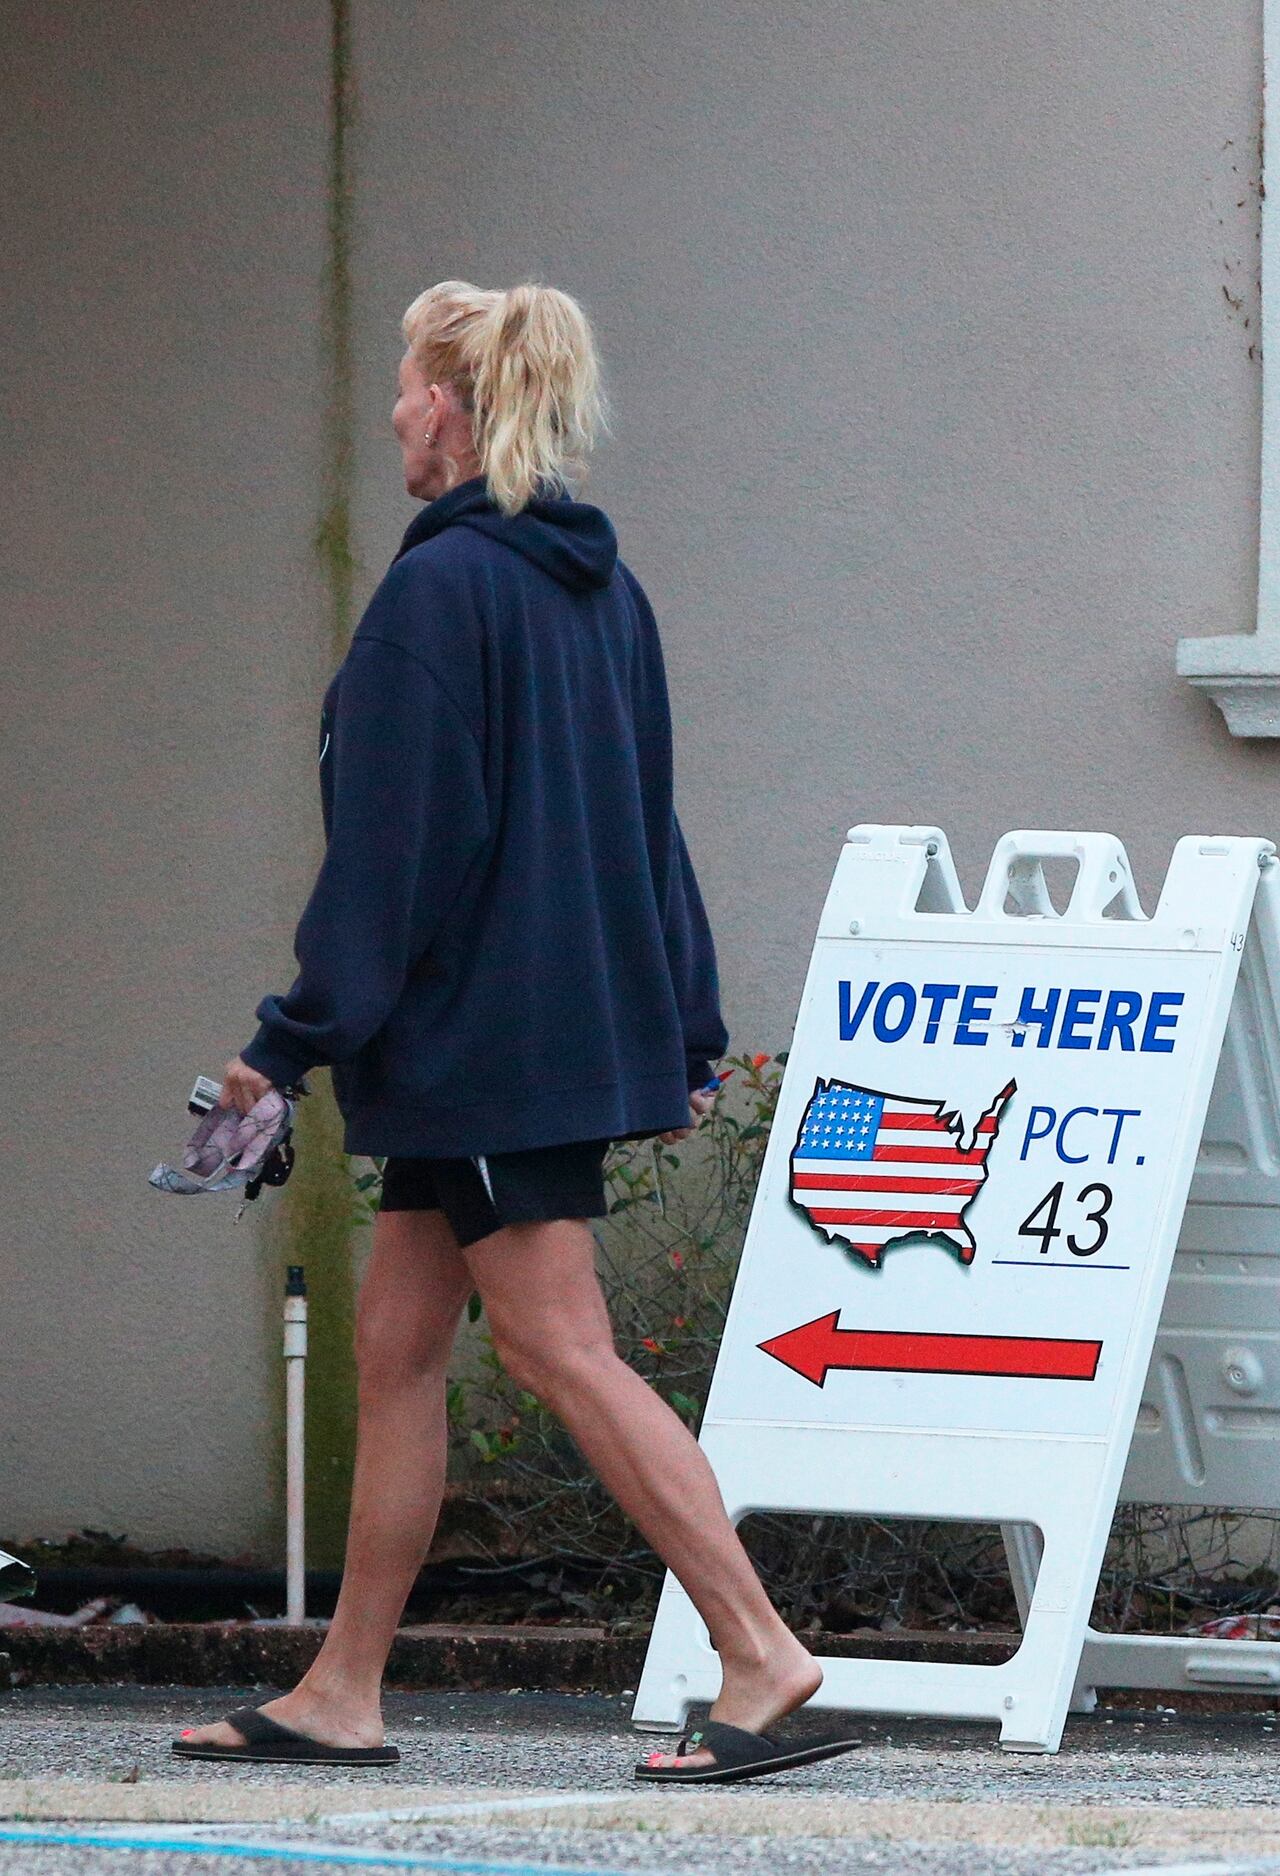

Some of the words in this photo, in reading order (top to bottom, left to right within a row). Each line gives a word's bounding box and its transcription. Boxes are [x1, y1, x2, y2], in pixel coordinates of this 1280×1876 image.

[1230, 931, 1245, 952] 43
[837, 980, 998, 1045] VOTE
[1012, 987, 1186, 1053] HERE
[1019, 1106, 1145, 1166] PCT.
[1018, 1181, 1113, 1257] 43
